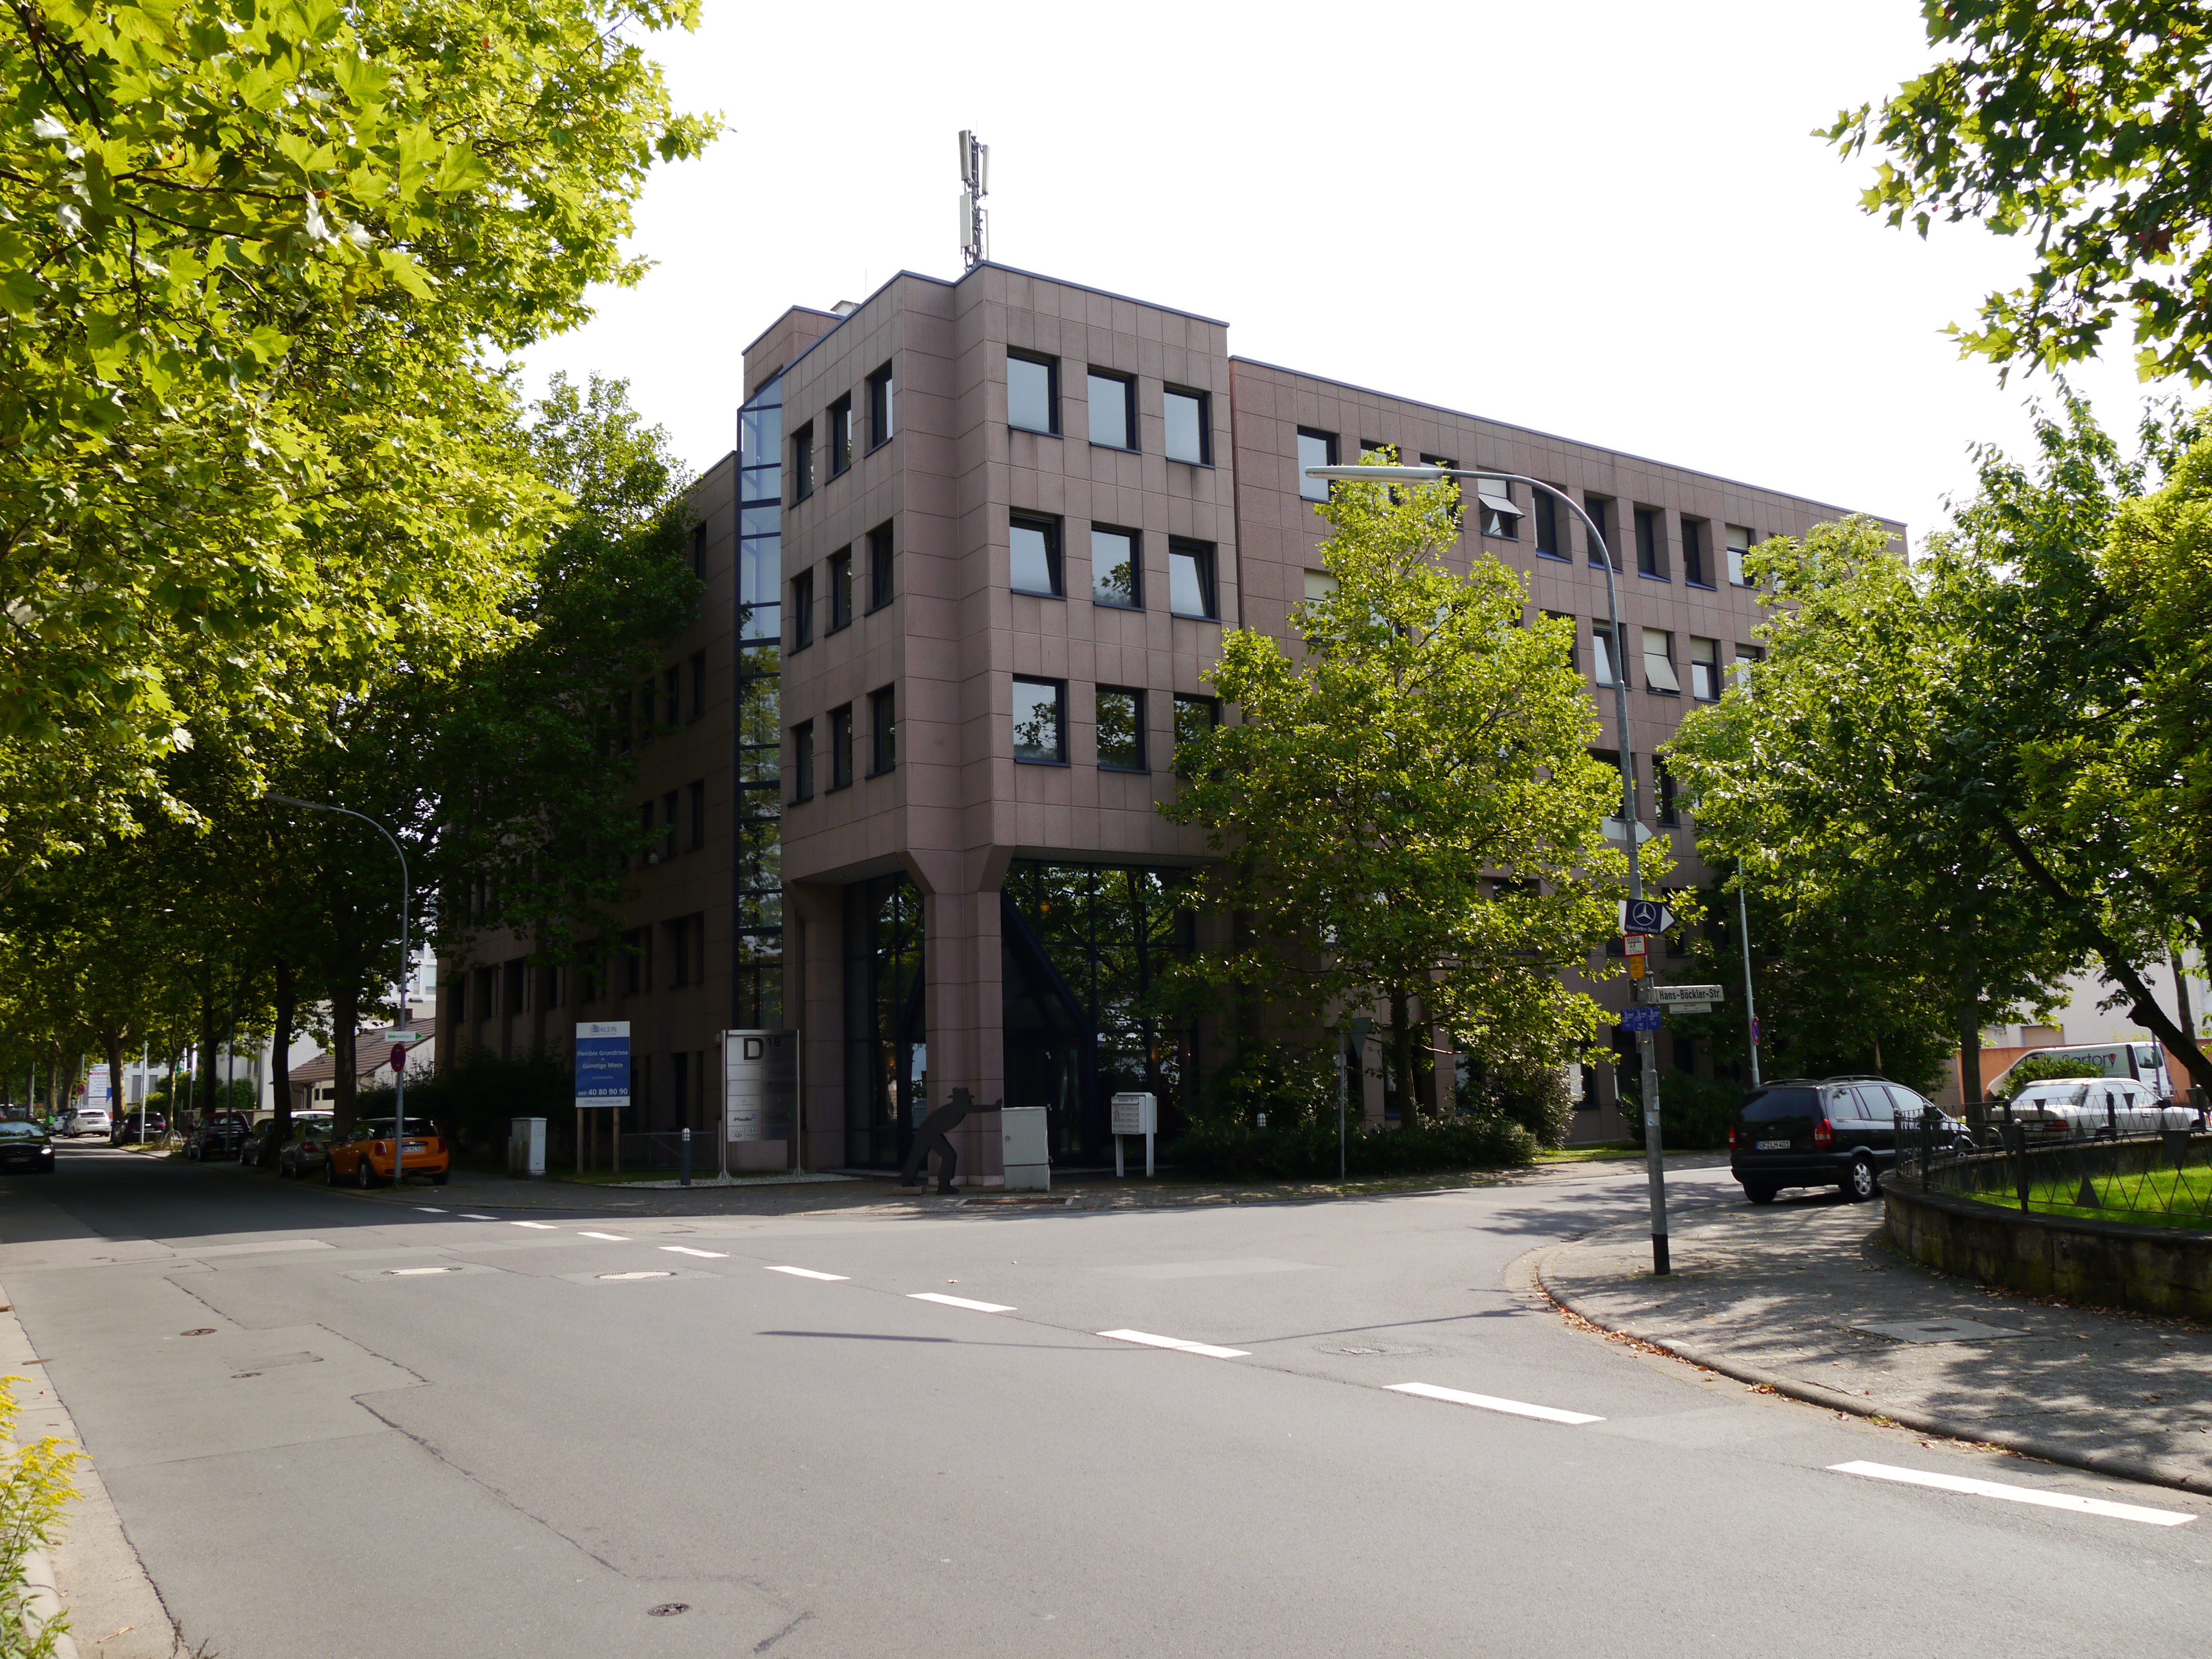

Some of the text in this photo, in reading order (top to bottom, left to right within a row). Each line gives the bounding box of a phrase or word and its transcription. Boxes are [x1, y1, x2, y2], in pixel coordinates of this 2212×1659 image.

[1626, 925, 1659, 933] Mercedes-Benz
[744, 1037, 781, 1060] D 18
